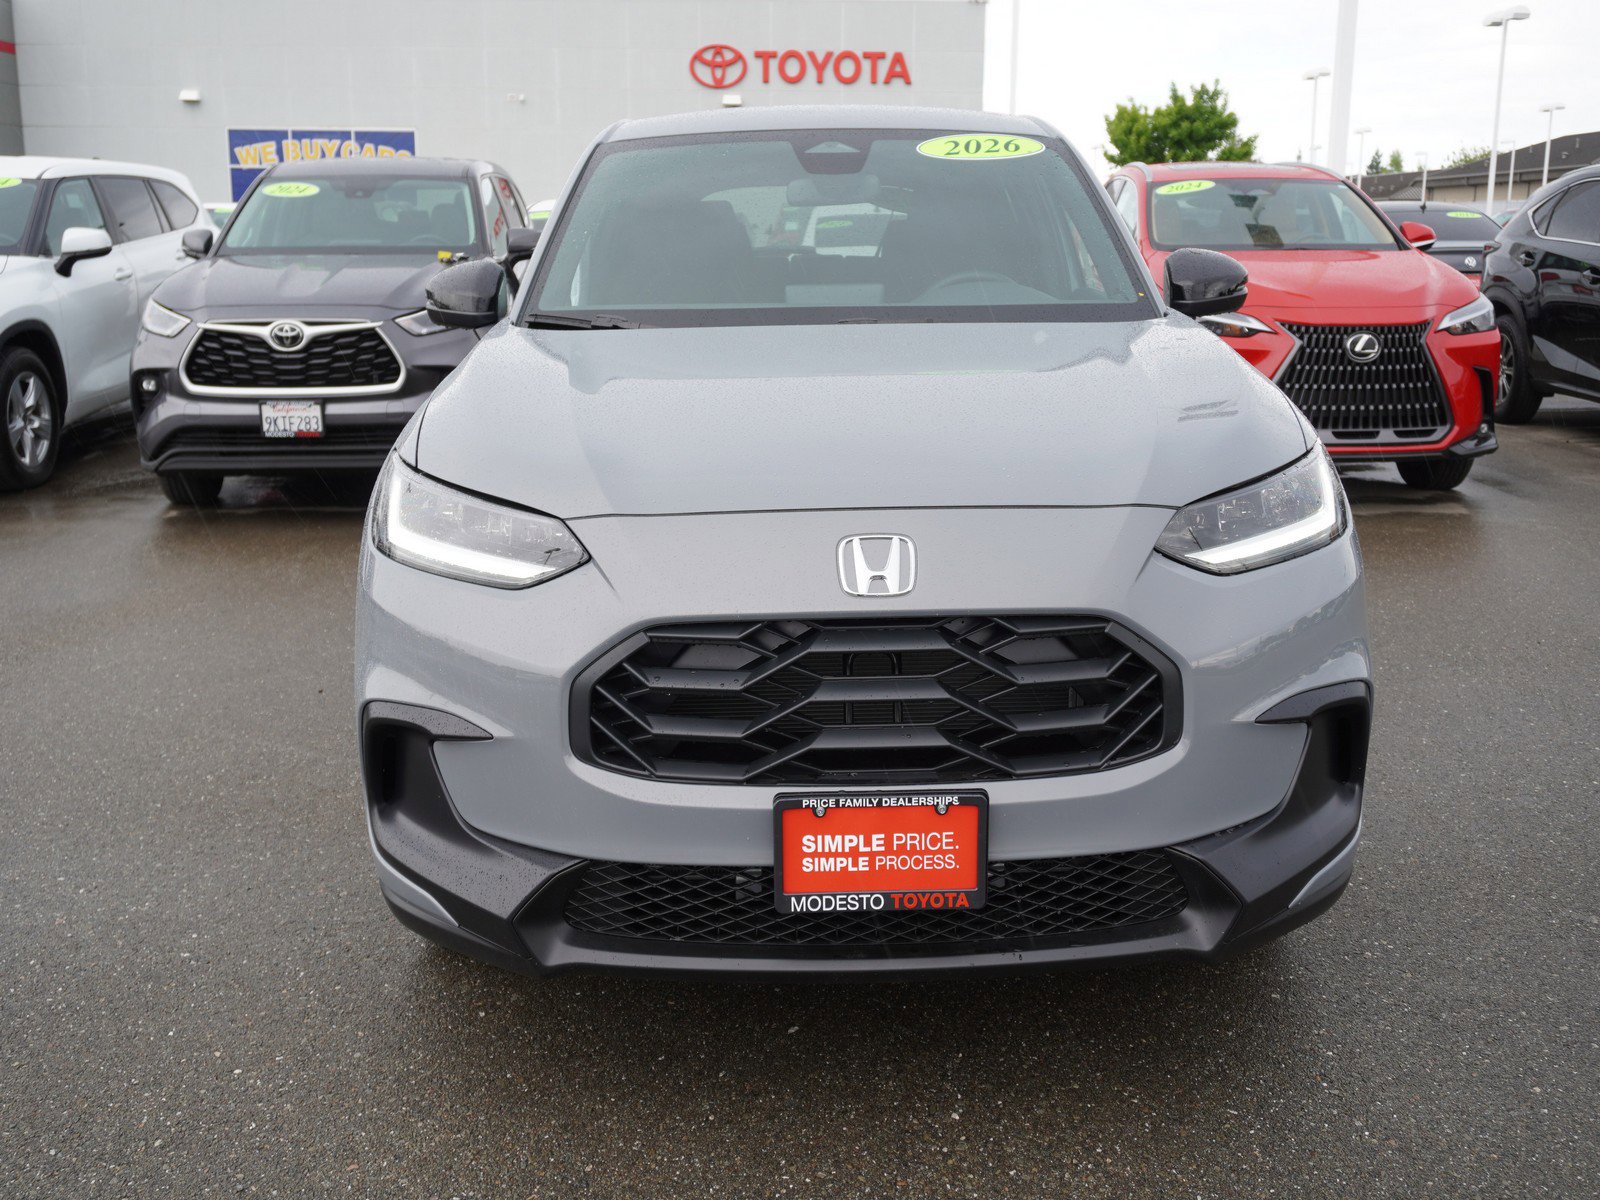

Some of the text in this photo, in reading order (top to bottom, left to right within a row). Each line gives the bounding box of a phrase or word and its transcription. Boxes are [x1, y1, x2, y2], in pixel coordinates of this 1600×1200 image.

[754, 49, 912, 85] TOYOTA
[234, 140, 278, 169] WE
[282, 138, 340, 161] BUY
[943, 138, 1021, 156] 2026
[264, 415, 320, 432] 9KIF283
[802, 795, 960, 809] PRICE FAMILY DEALERSHIPS
[801, 831, 960, 853] SIMPLE PRICE.
[801, 853, 960, 872] SIMPLE PROCESS.
[790, 892, 970, 912] MODESTO TOYOTA
